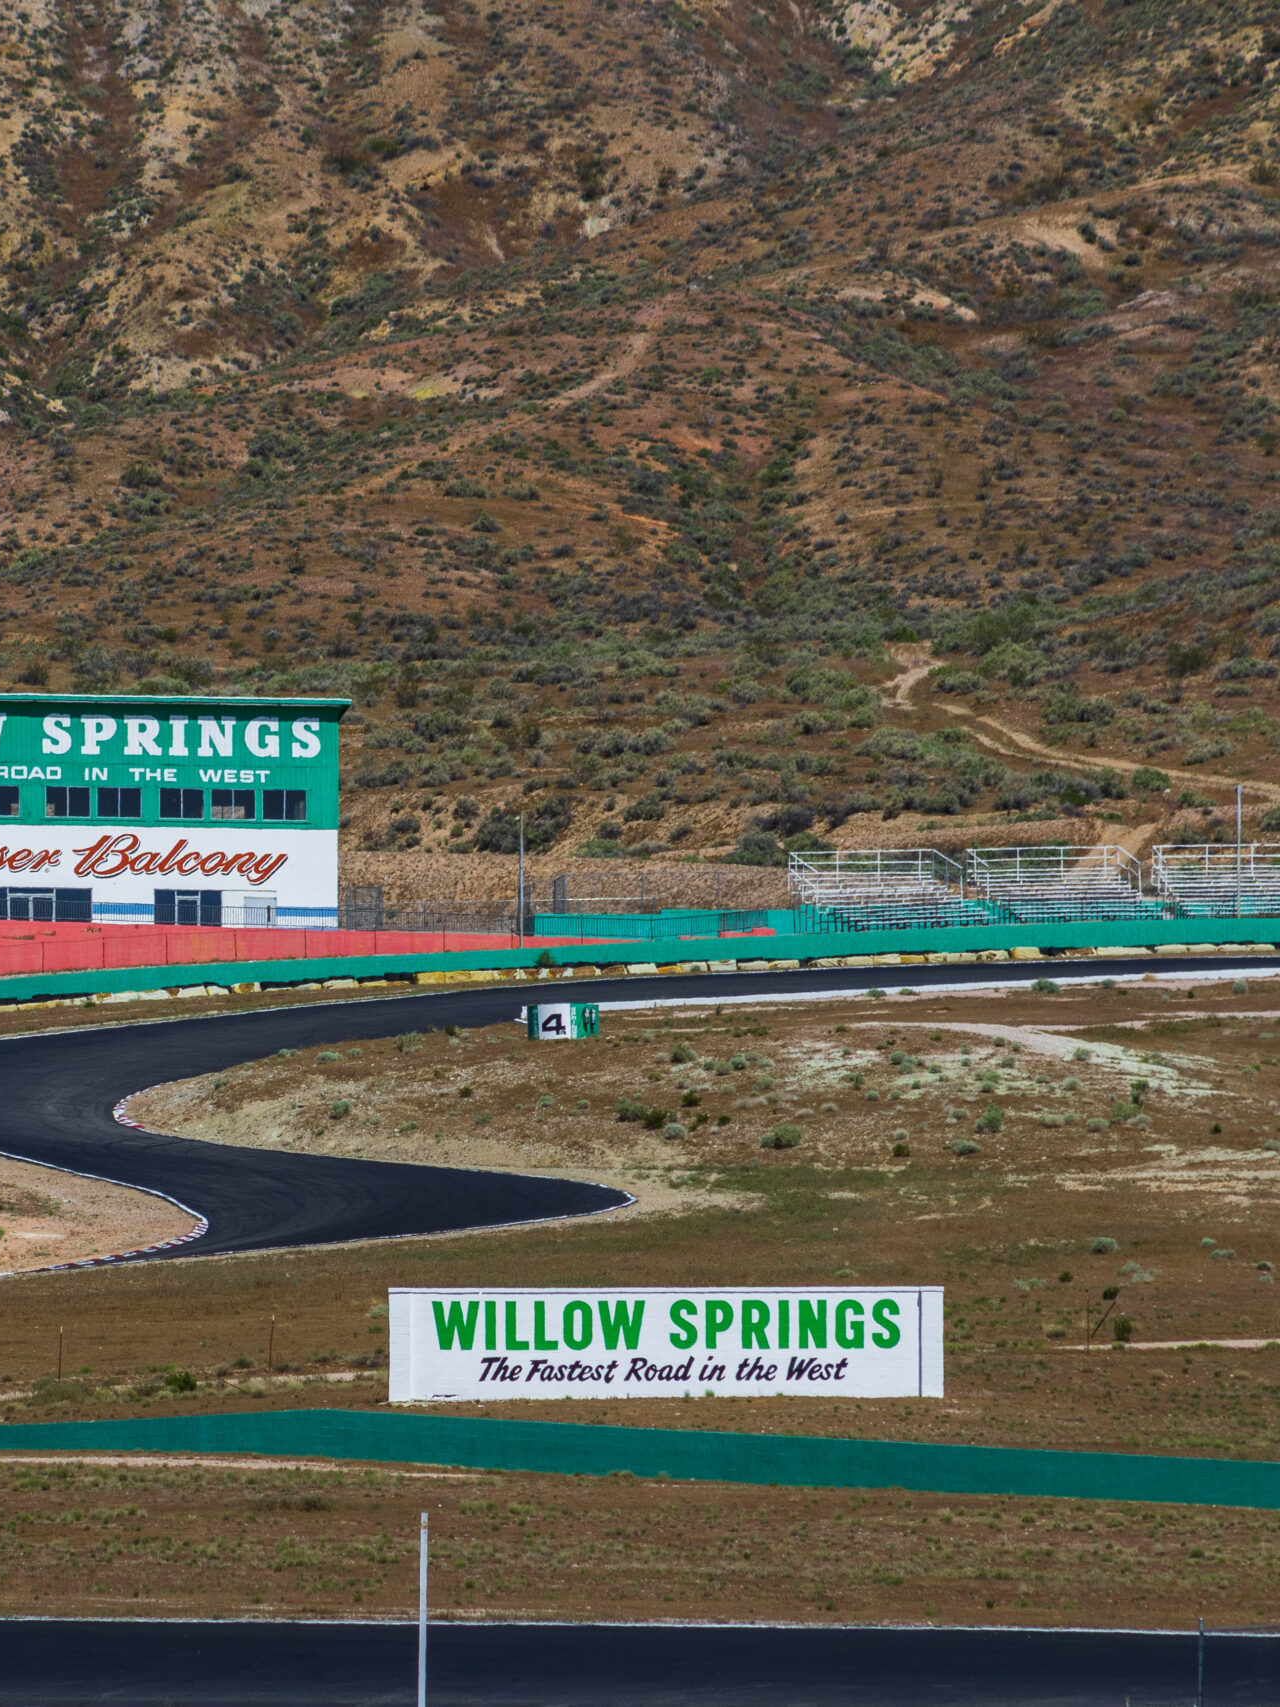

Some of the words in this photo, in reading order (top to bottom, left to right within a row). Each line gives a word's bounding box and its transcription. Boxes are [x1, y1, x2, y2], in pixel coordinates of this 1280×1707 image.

[42, 714, 322, 758] SPRINGS
[84, 767, 108, 781] IN
[128, 767, 177, 782] THE
[199, 769, 271, 784] WEST
[72, 833, 288, 885] Balcony
[542, 1014, 566, 1035] 4
[431, 1299, 646, 1351] WILLOW
[669, 1298, 901, 1350] SPRINGS
[478, 1356, 522, 1383] The
[525, 1358, 618, 1384] Fastest
[624, 1356, 695, 1382] Road
[697, 1358, 726, 1382] in
[735, 1356, 778, 1382] the
[784, 1356, 849, 1381] West
